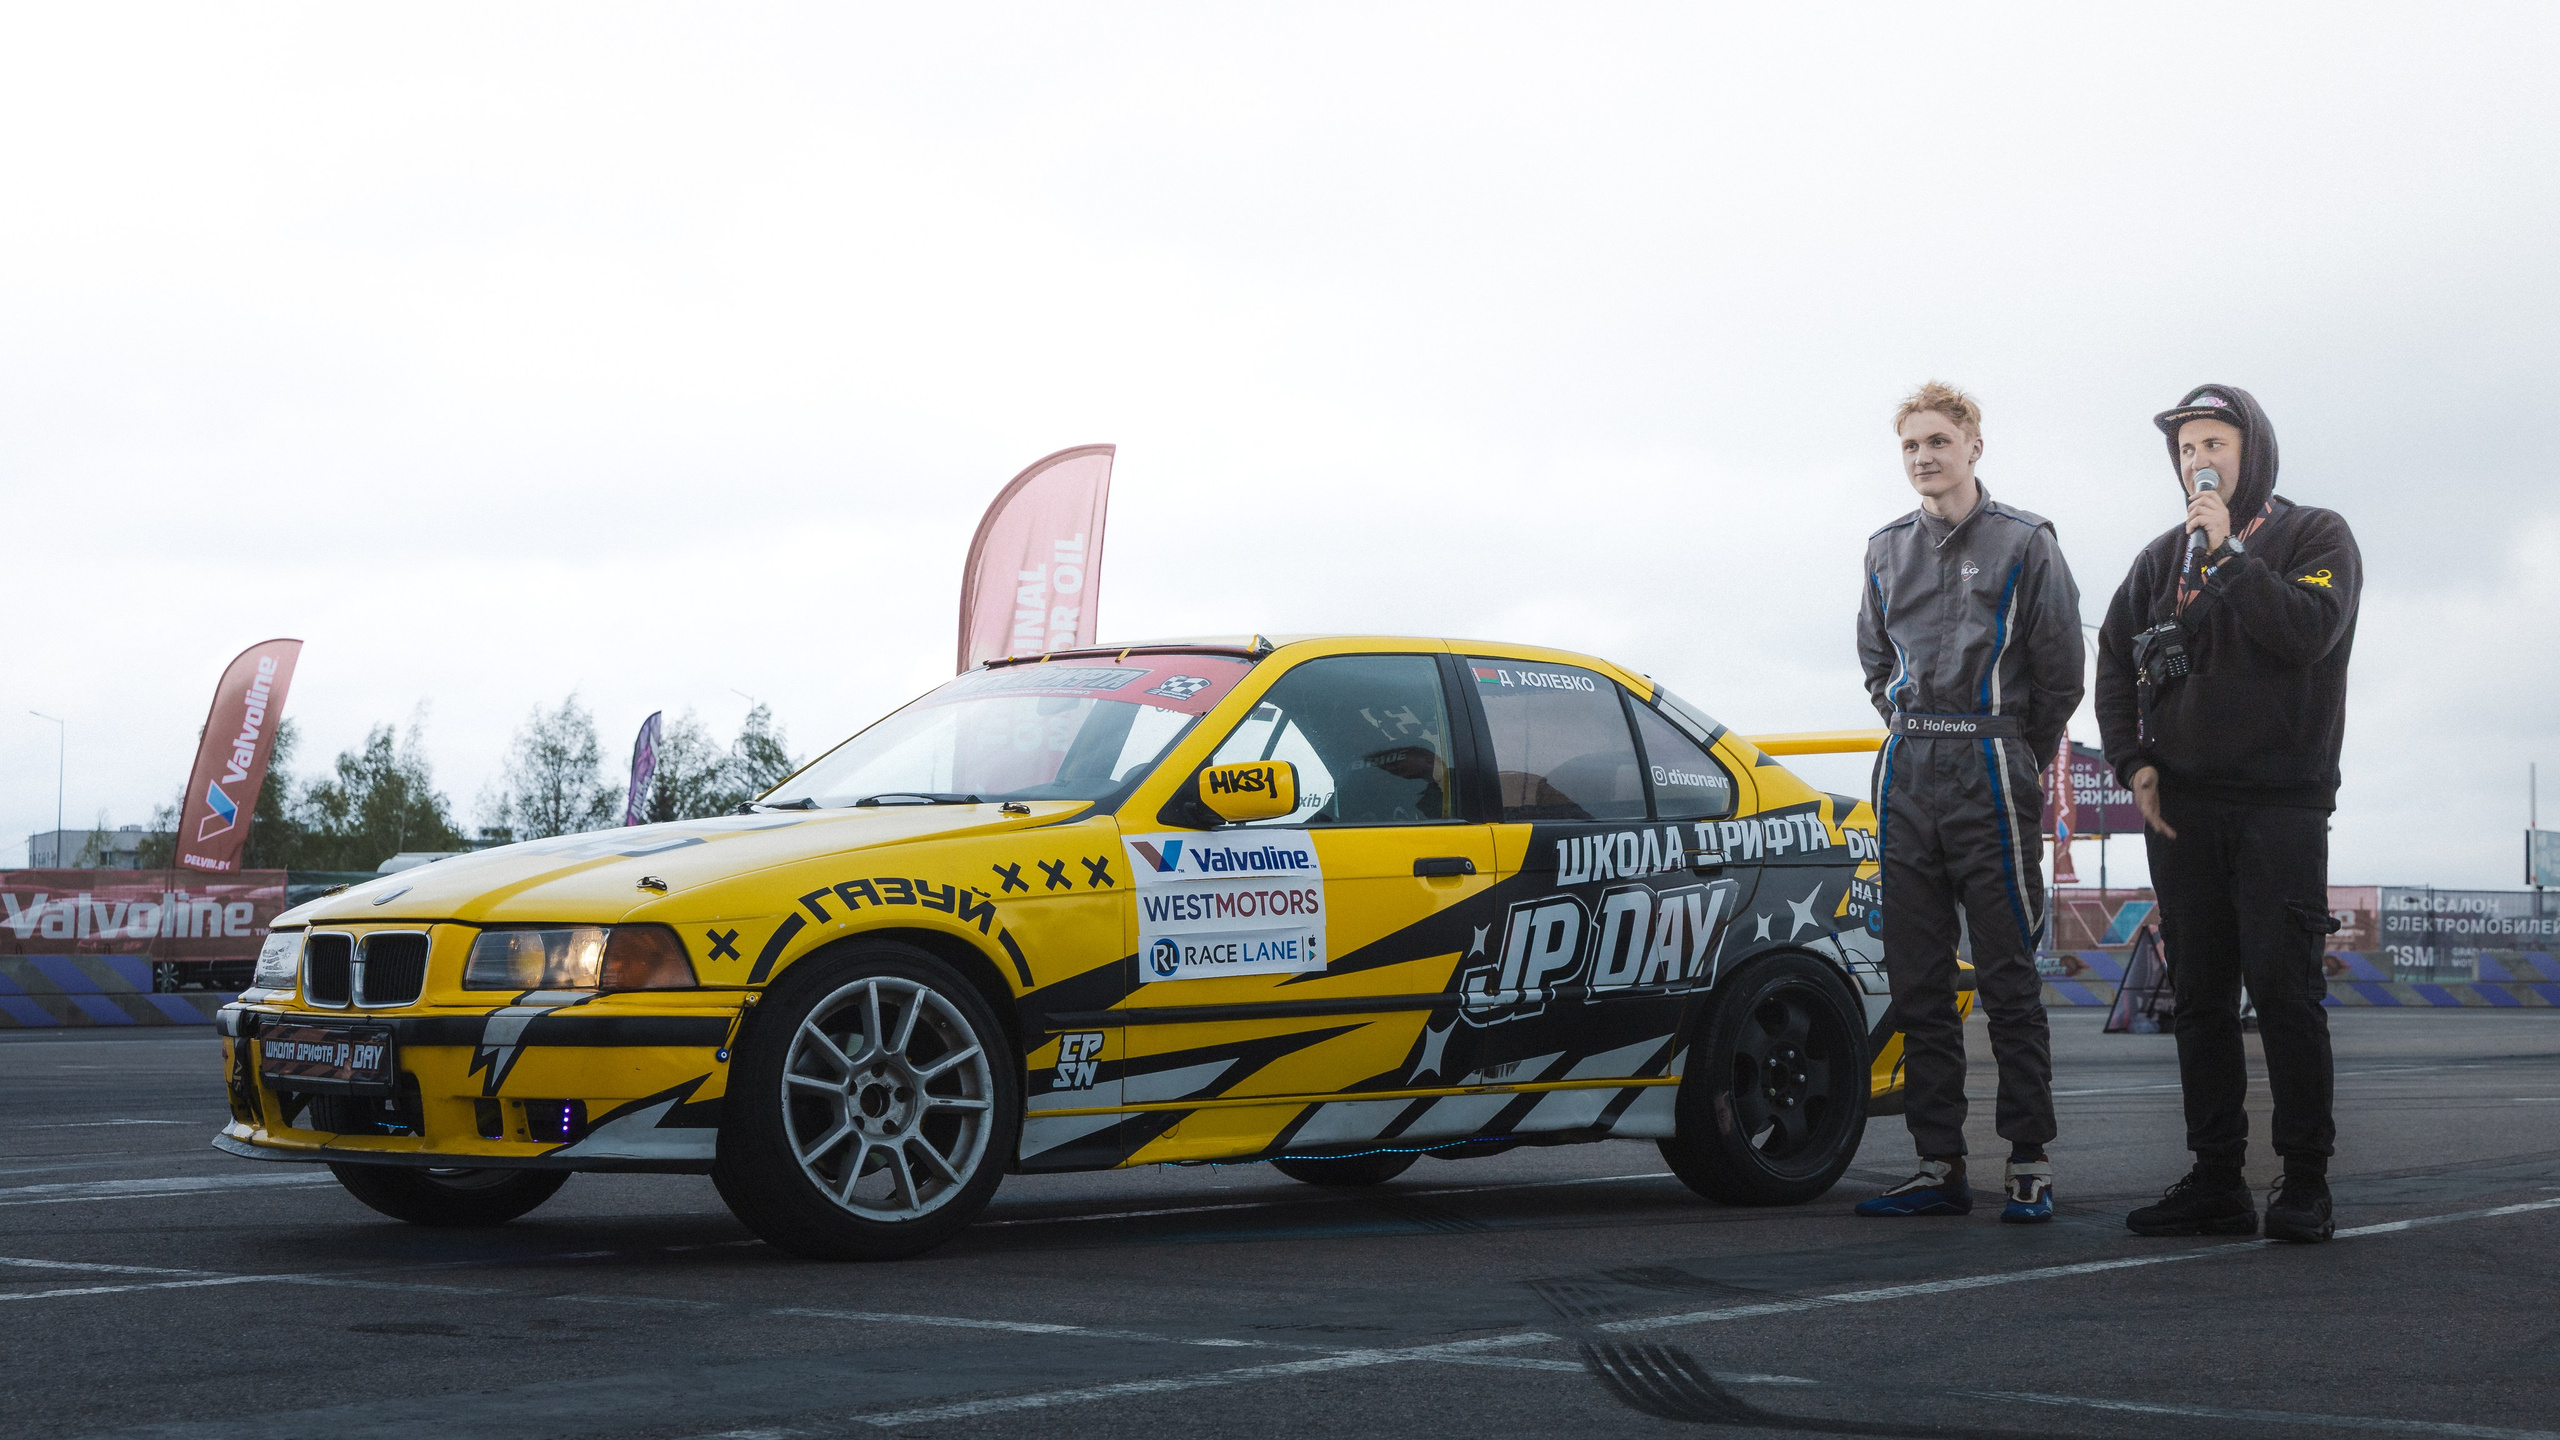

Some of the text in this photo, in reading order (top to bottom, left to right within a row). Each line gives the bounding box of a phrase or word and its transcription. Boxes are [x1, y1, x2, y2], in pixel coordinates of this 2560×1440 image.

[1053, 533, 1085, 594] OIL
[1516, 670, 1595, 692] ХОЛЕВКО
[222, 655, 277, 784] Valvoline
[1907, 719, 1977, 732] D. Holevko
[1189, 845, 1309, 873] Valvoline
[1556, 812, 1831, 887] ШКОЛА ДРИФТА
[3, 892, 254, 939] Valvoline
[797, 877, 997, 936] ГАЗУЙ
[1143, 888, 1319, 922] WESTMOTORS
[1184, 943, 1238, 966] RACE
[1243, 940, 1298, 962] LANE
[1462, 887, 1728, 1011] JP DAY
[265, 1040, 384, 1070] ШКОЛА ДРИФТА JP DAY
